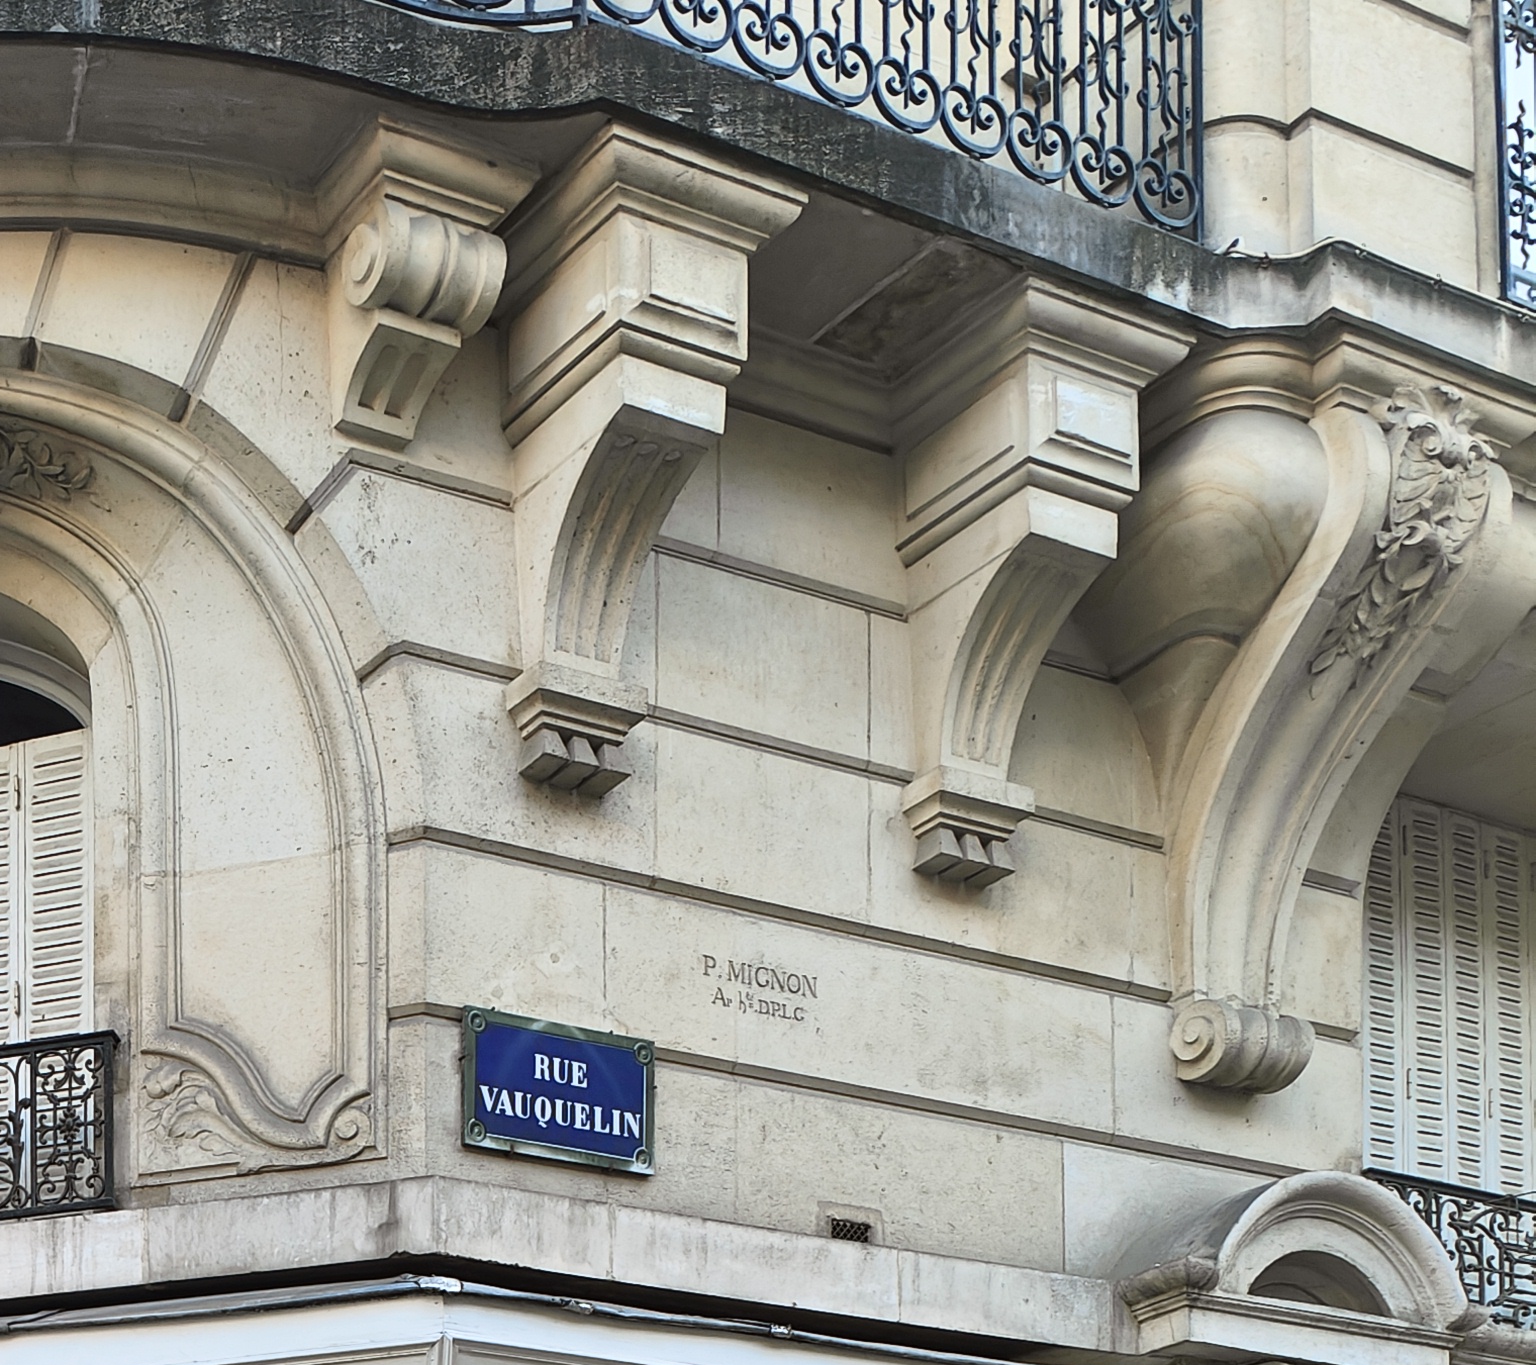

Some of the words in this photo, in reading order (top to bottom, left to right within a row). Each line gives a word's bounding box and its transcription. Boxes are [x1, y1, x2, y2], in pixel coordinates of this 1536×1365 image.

[726, 959, 818, 999] MIGNON
[533, 1053, 588, 1089] RUE
[478, 1084, 642, 1139] VAUQUELIN
